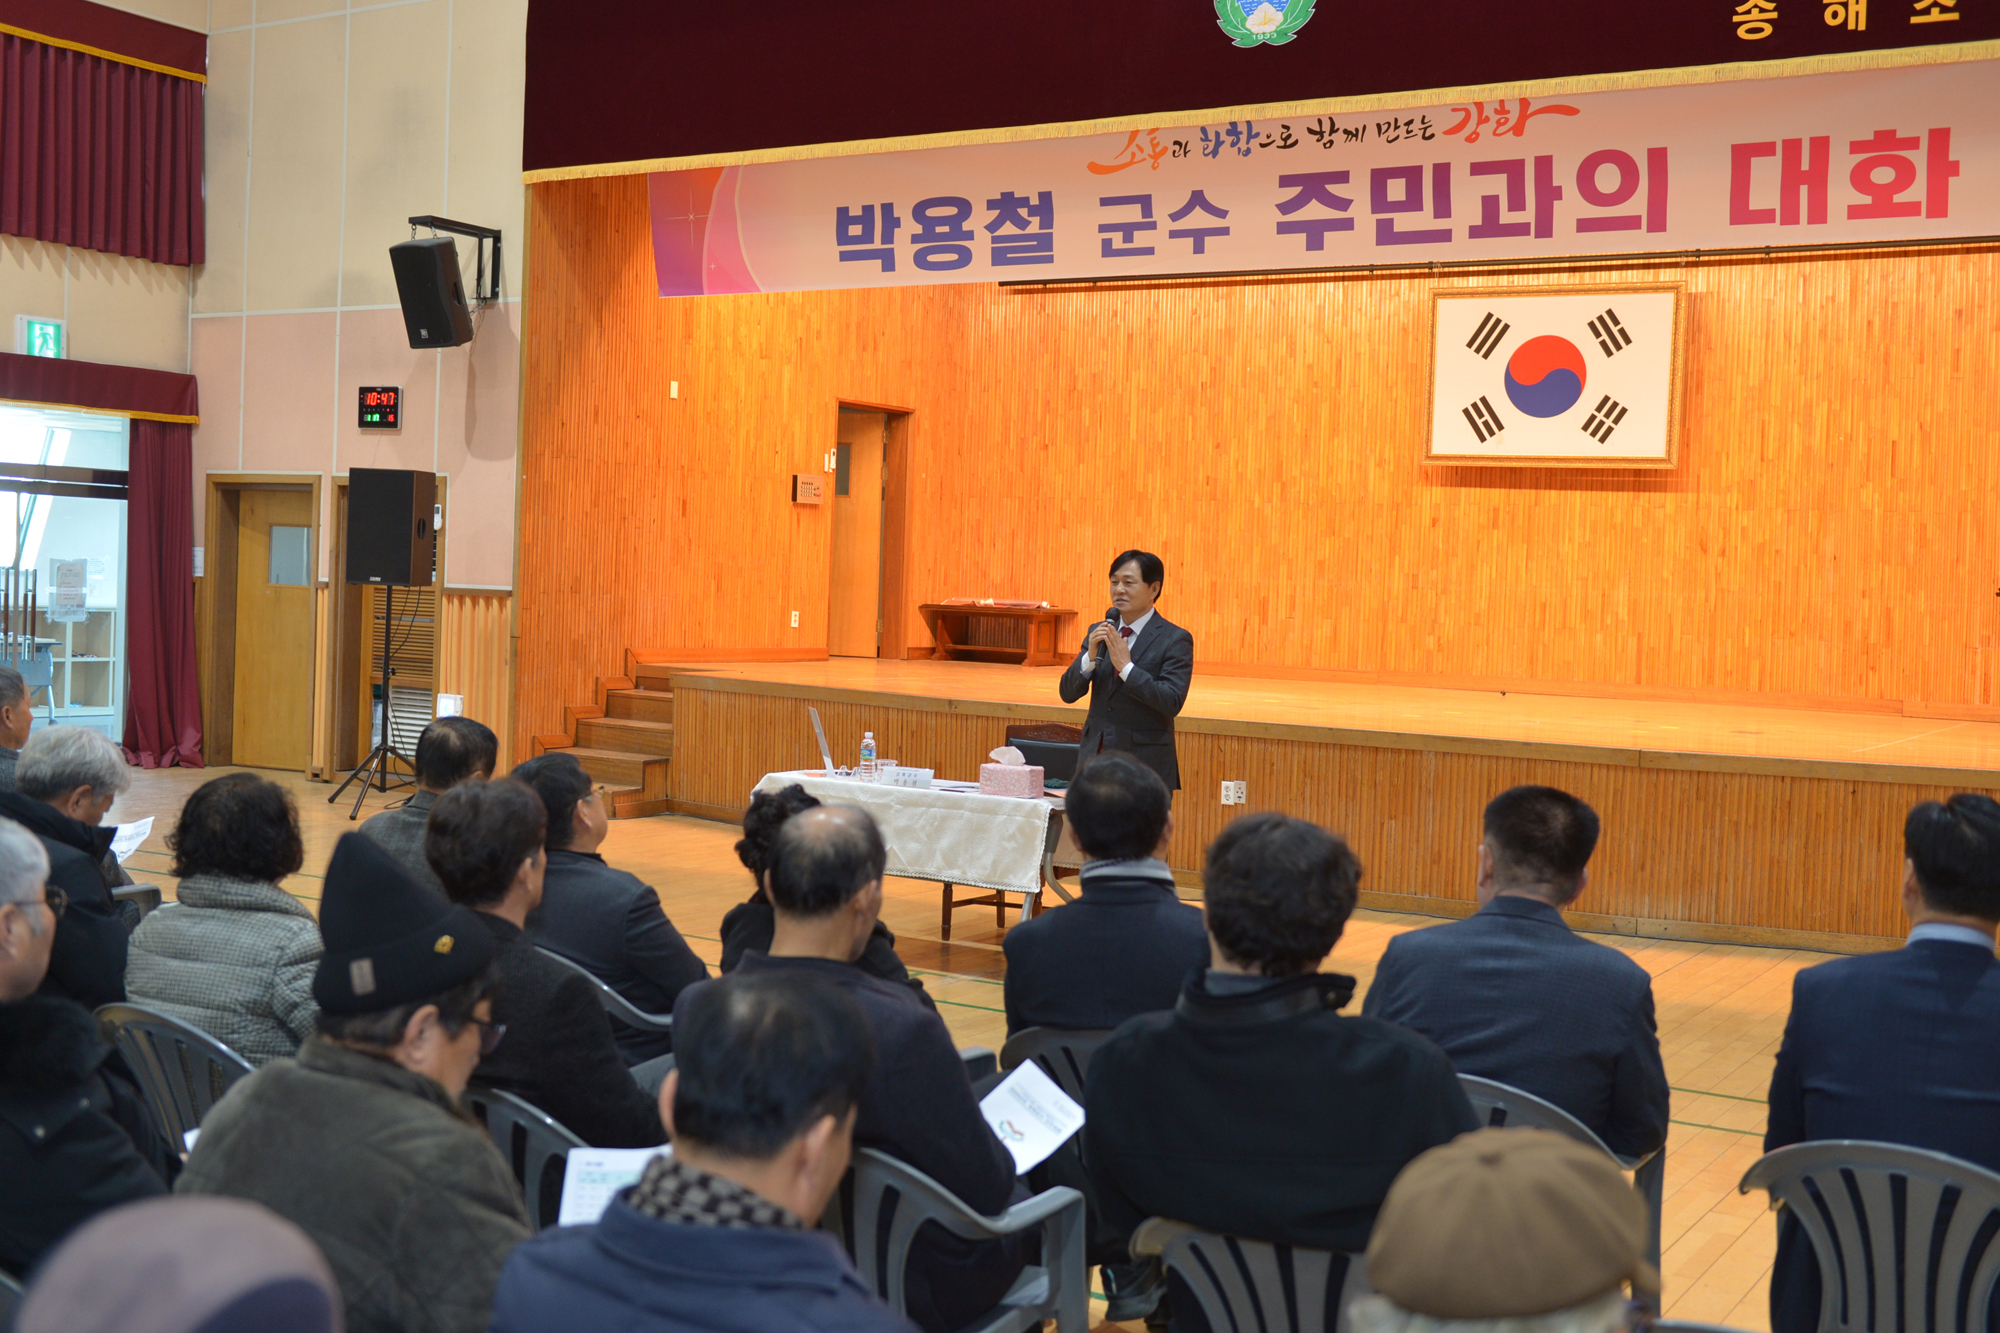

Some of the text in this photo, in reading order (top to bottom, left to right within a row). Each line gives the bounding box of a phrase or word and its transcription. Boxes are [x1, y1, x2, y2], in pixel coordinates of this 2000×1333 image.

[1252, 32, 1277, 41] 1933
[1306, 116, 1366, 149] 함께
[1375, 115, 1435, 144] 만드는
[1442, 97, 1581, 144] 강화
[836, 127, 1960, 273] 박용철 군수 주민과의 대화
[365, 392, 396, 406] 10:47
